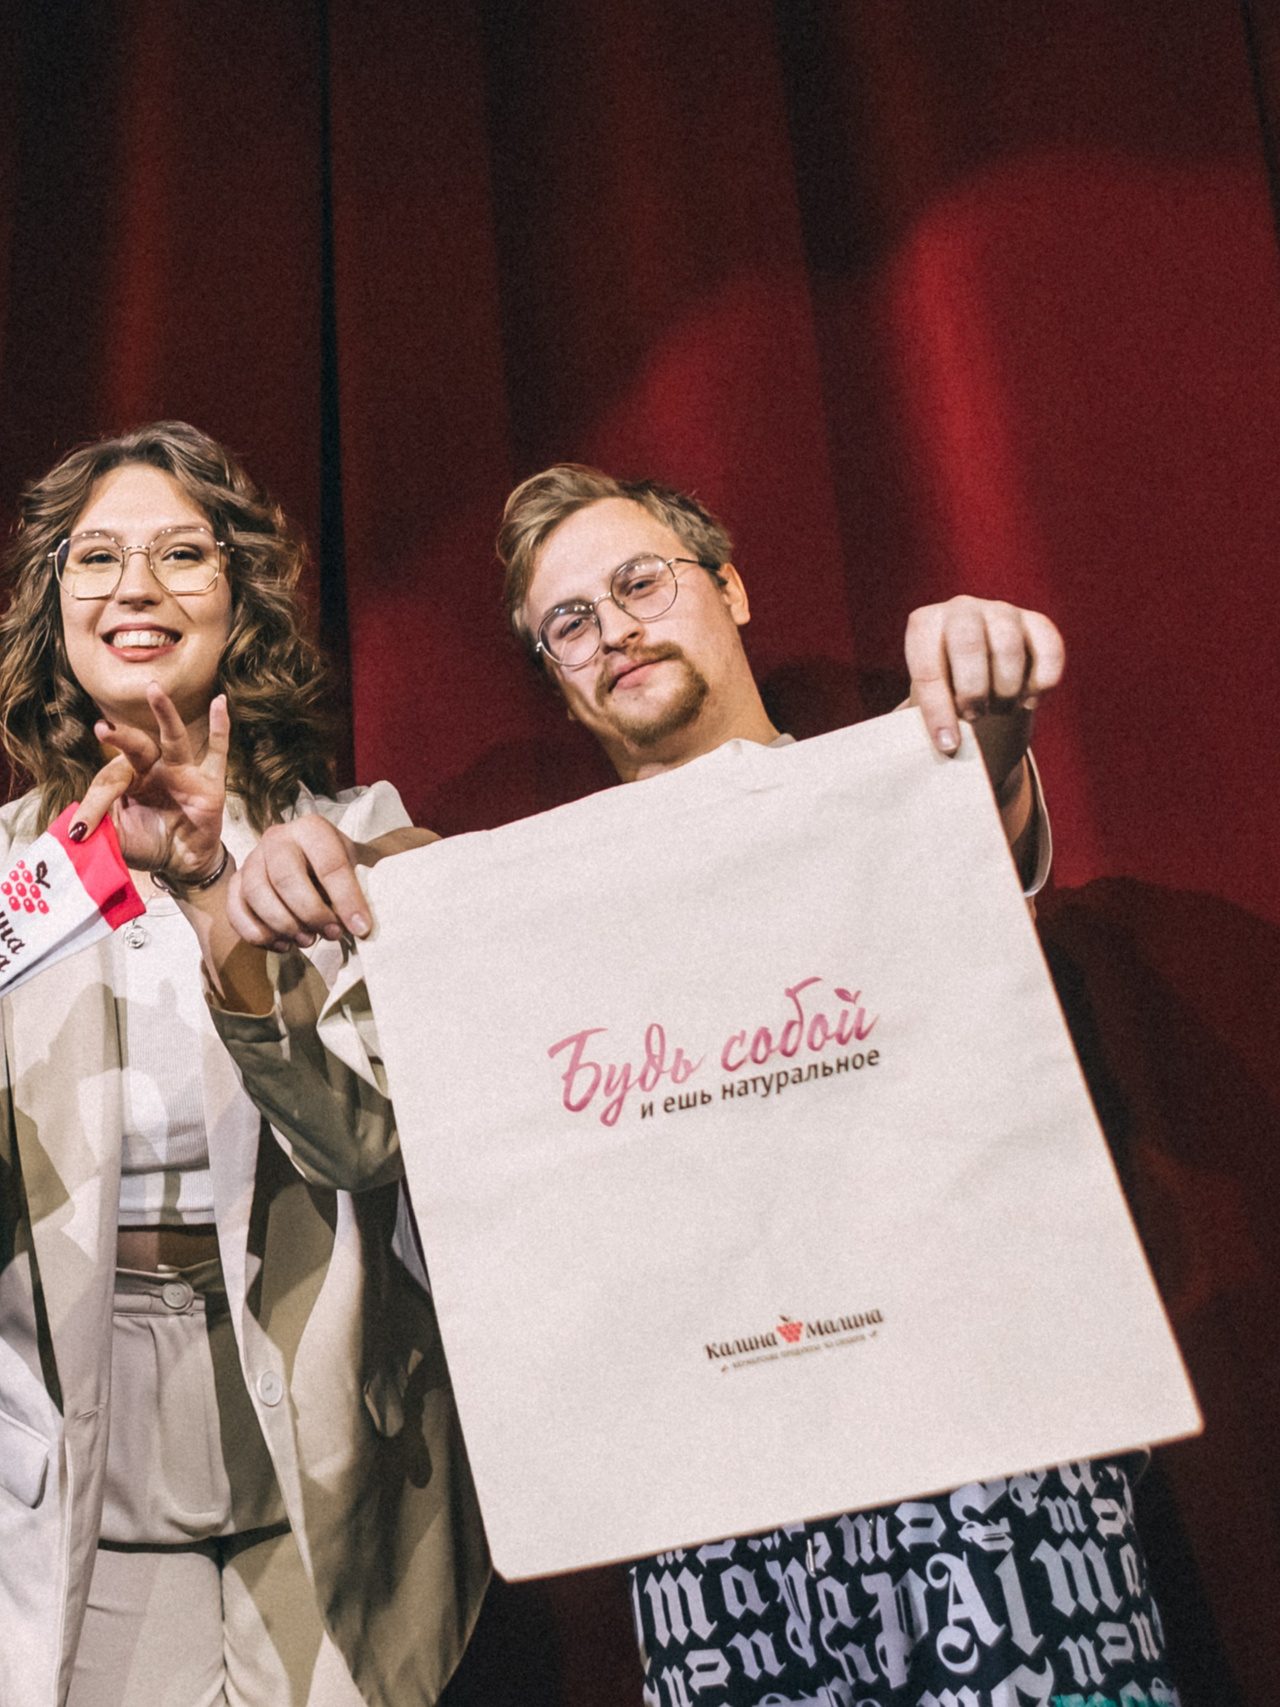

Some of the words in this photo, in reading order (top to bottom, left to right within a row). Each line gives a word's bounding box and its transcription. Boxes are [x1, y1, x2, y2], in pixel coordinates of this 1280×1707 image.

[547, 1023, 707, 1127] Будь
[721, 977, 880, 1072] собой
[640, 1102, 654, 1120] и
[663, 1088, 712, 1114] ешь
[721, 1049, 880, 1100] натуральное
[704, 1332, 779, 1361] Калина
[806, 1308, 884, 1339] Малина
